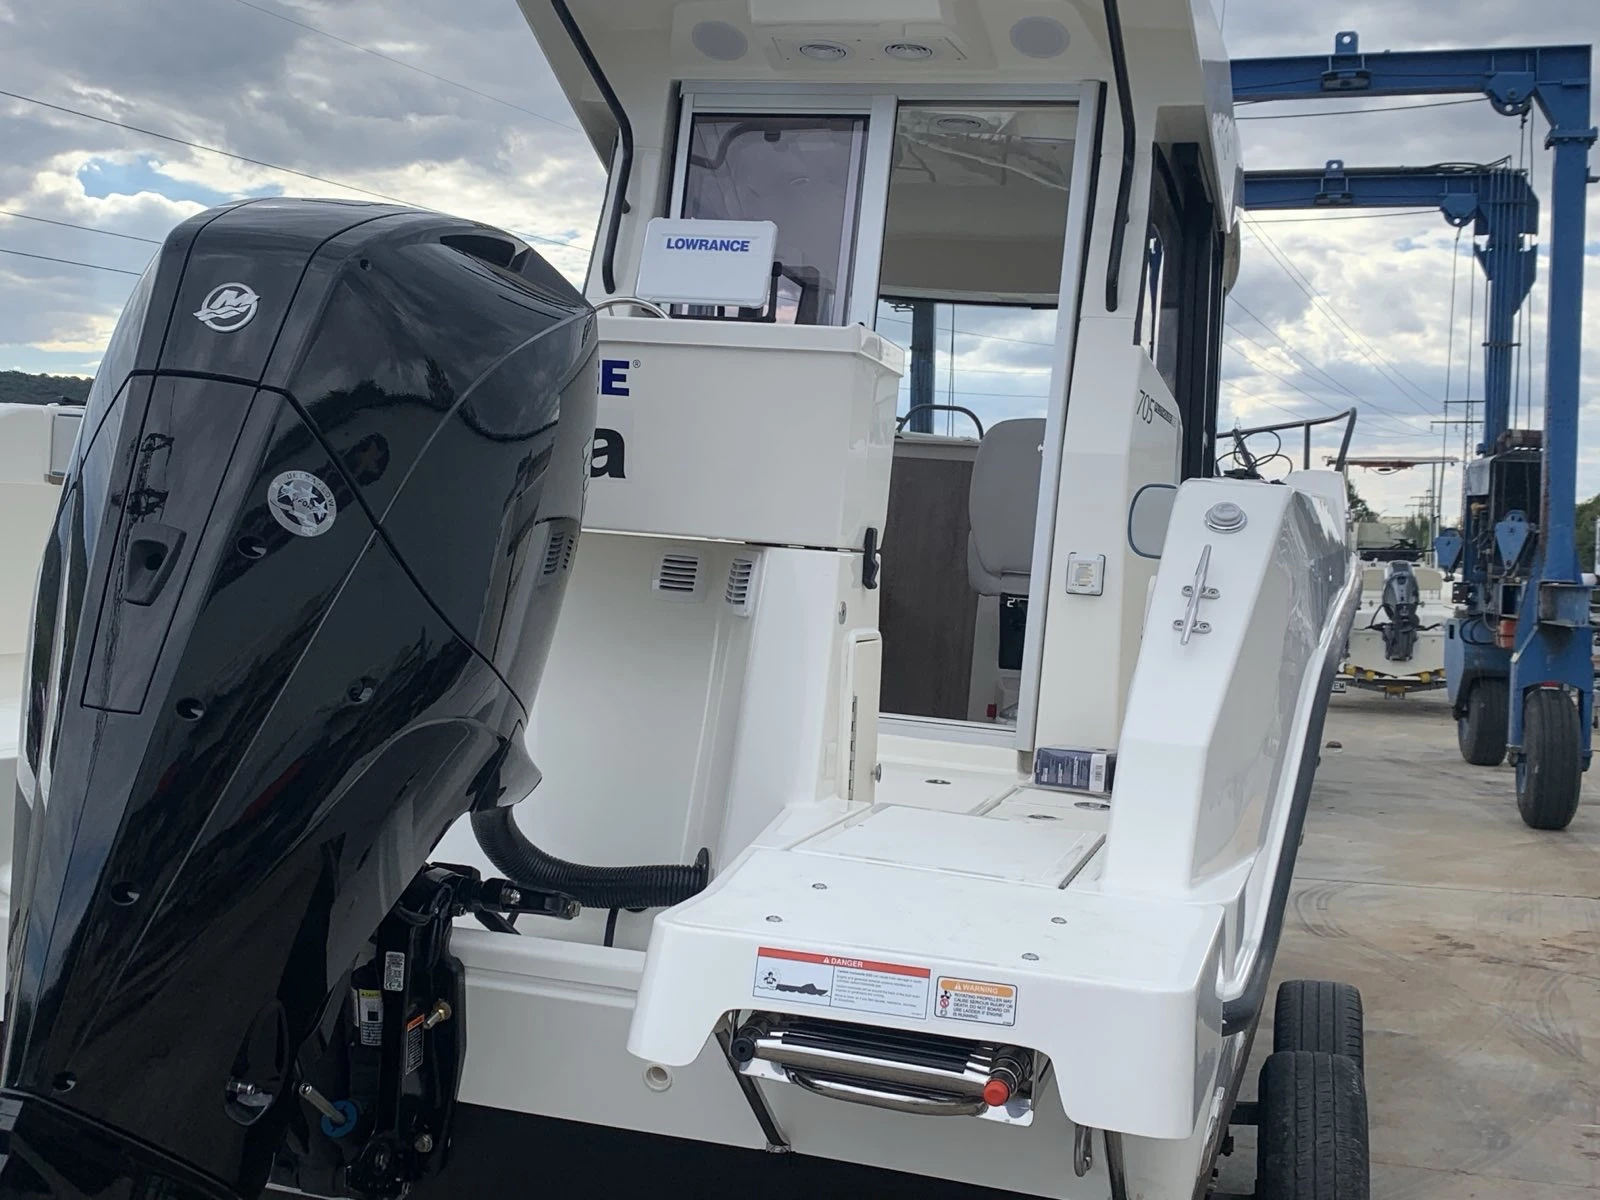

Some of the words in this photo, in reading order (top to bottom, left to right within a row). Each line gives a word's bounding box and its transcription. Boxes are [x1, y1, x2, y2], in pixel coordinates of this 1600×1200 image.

[666, 238, 750, 252] LOWRANCE
[1136, 389, 1155, 424] 705
[831, 959, 863, 968] DANGER
[962, 983, 998, 994] WARNING
